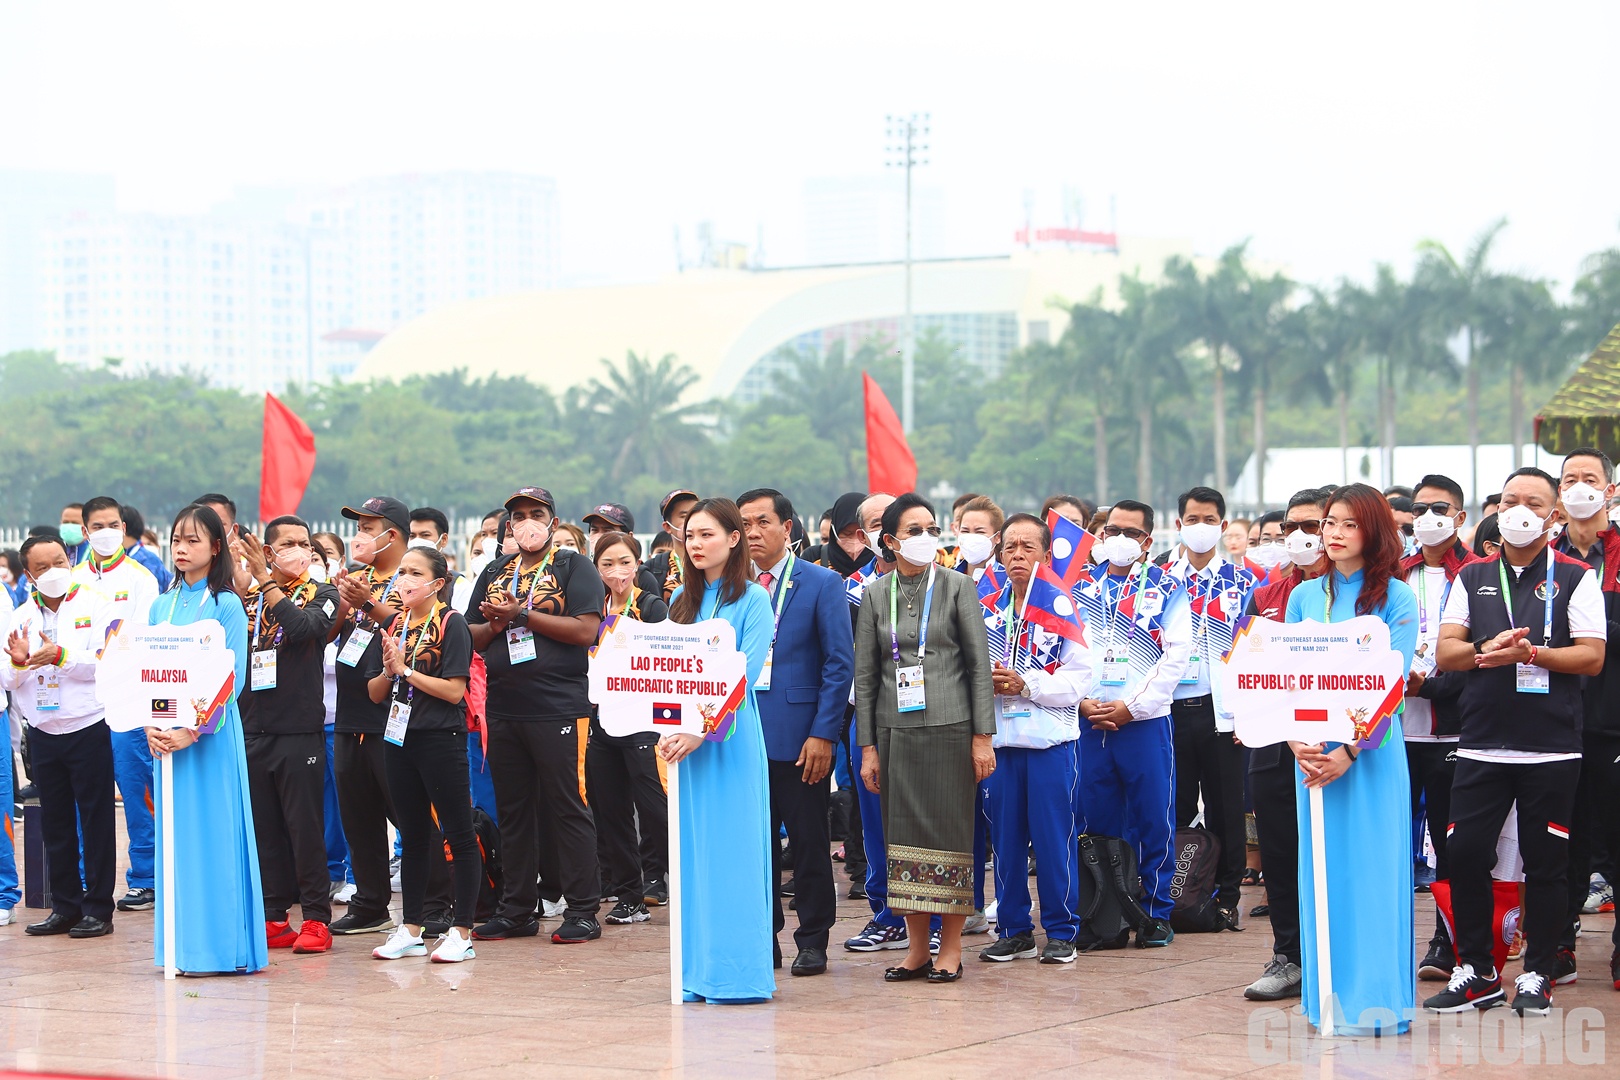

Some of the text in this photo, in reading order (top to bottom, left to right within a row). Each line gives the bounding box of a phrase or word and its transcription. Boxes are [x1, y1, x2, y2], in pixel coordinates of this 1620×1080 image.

[631, 655, 703, 673] LAO PEOPLE'S
[141, 669, 188, 683] MALAYSIA
[1238, 674, 1386, 691] REPUBLIC OF INDONESIA
[607, 676, 727, 697] DEMOCRATIC REPUBLIC
[1169, 844, 1198, 898] adidas
